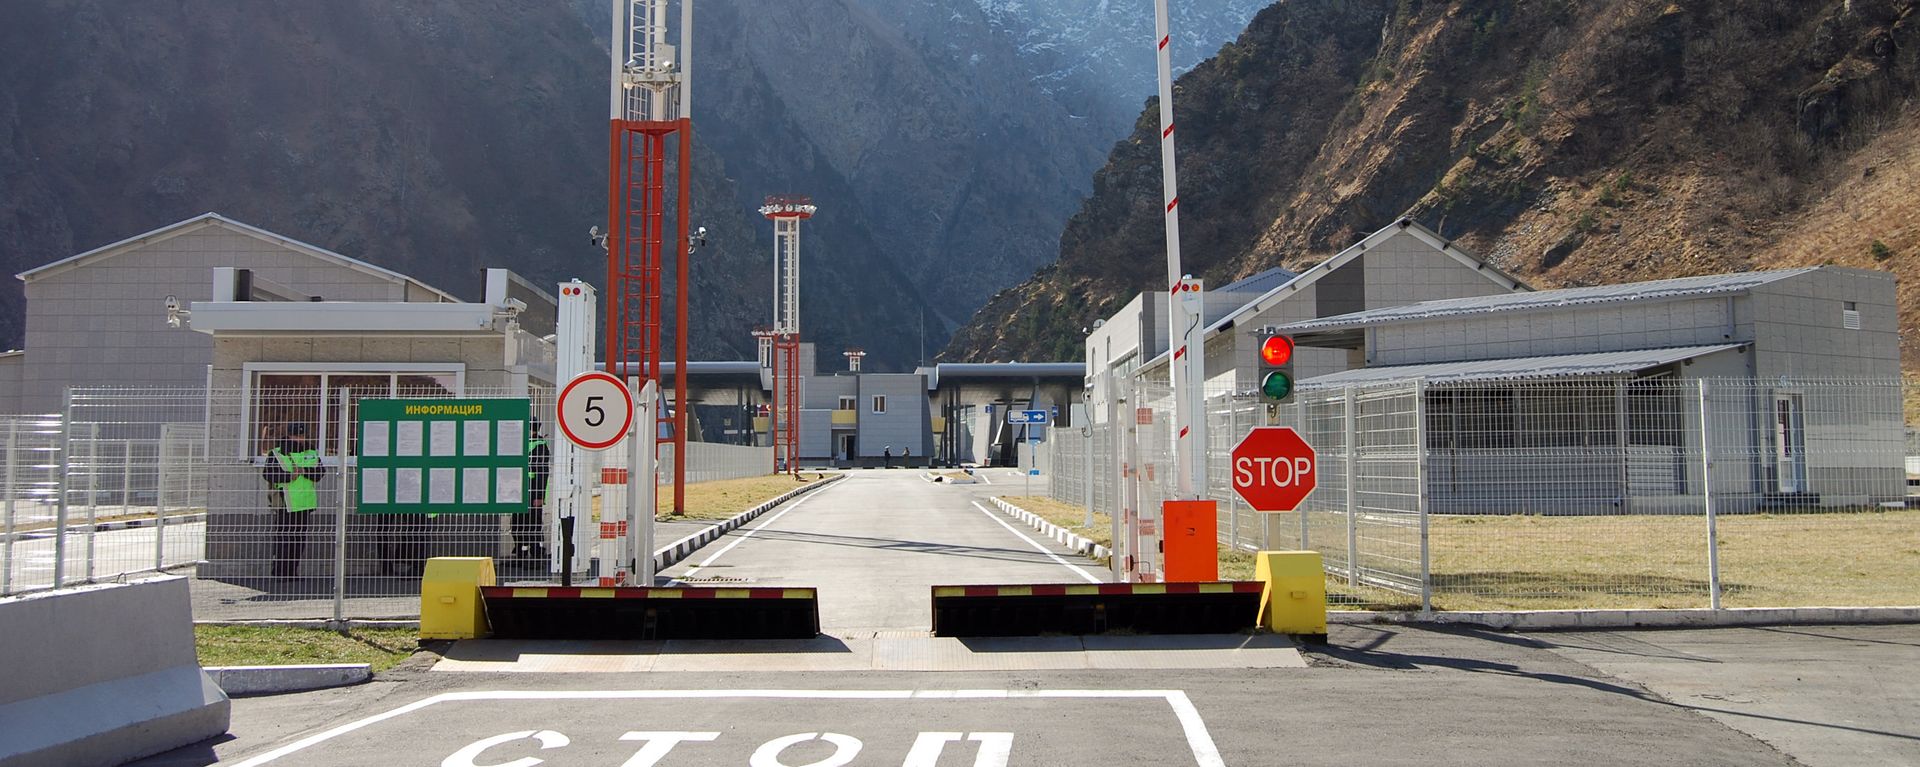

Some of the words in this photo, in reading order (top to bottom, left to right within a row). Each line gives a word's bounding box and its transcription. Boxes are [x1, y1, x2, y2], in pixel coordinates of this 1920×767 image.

[405, 405, 483, 416] ИНФОРМАЦИЯ
[584, 396, 605, 427] 5
[1235, 456, 1311, 487] STOP
[440, 729, 1015, 767] СТОП
